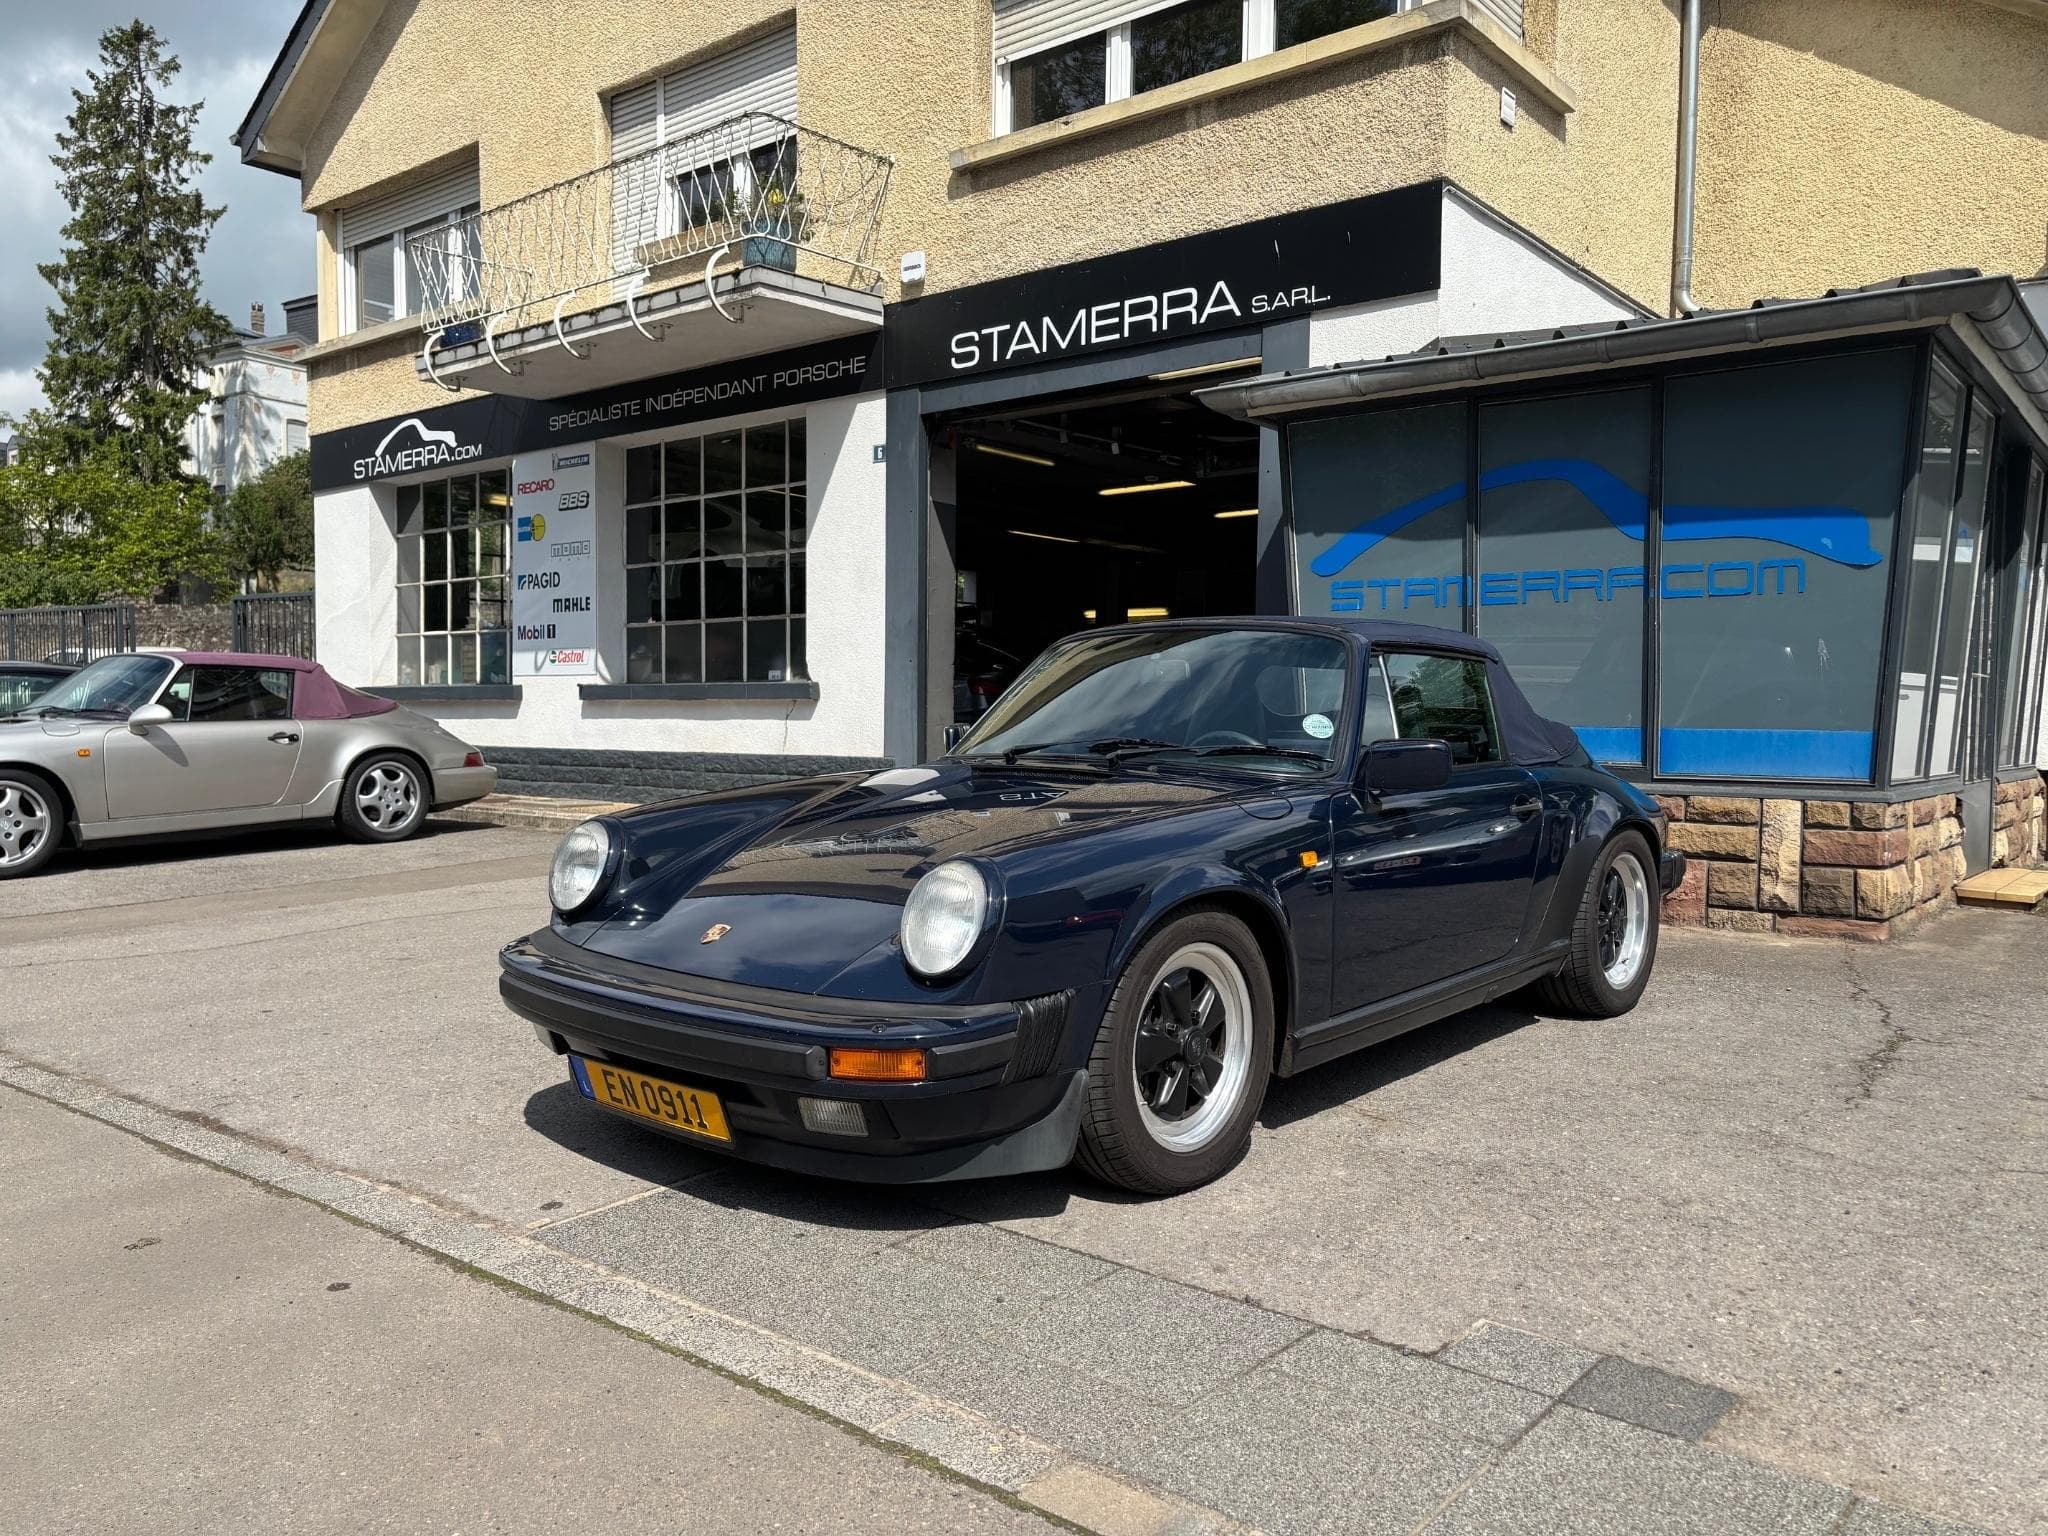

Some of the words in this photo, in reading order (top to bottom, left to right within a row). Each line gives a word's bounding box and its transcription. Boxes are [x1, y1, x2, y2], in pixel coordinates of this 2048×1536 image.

[950, 280, 1242, 369] STAMERRA
[549, 399, 641, 431] SPÉCIALISTE
[645, 374, 768, 413] INDÉPENDANT
[773, 355, 867, 389] PORSCHE
[353, 443, 483, 479] STAMERRA.COM
[517, 478, 555, 495] RECARO
[558, 490, 590, 511] BBS
[527, 571, 561, 589] PAGID
[552, 596, 591, 613] MAHLE
[517, 624, 545, 640] Mobil
[557, 649, 585, 663] Castrol
[601, 1068, 641, 1110] EN
[640, 1080, 710, 1130] 0911
